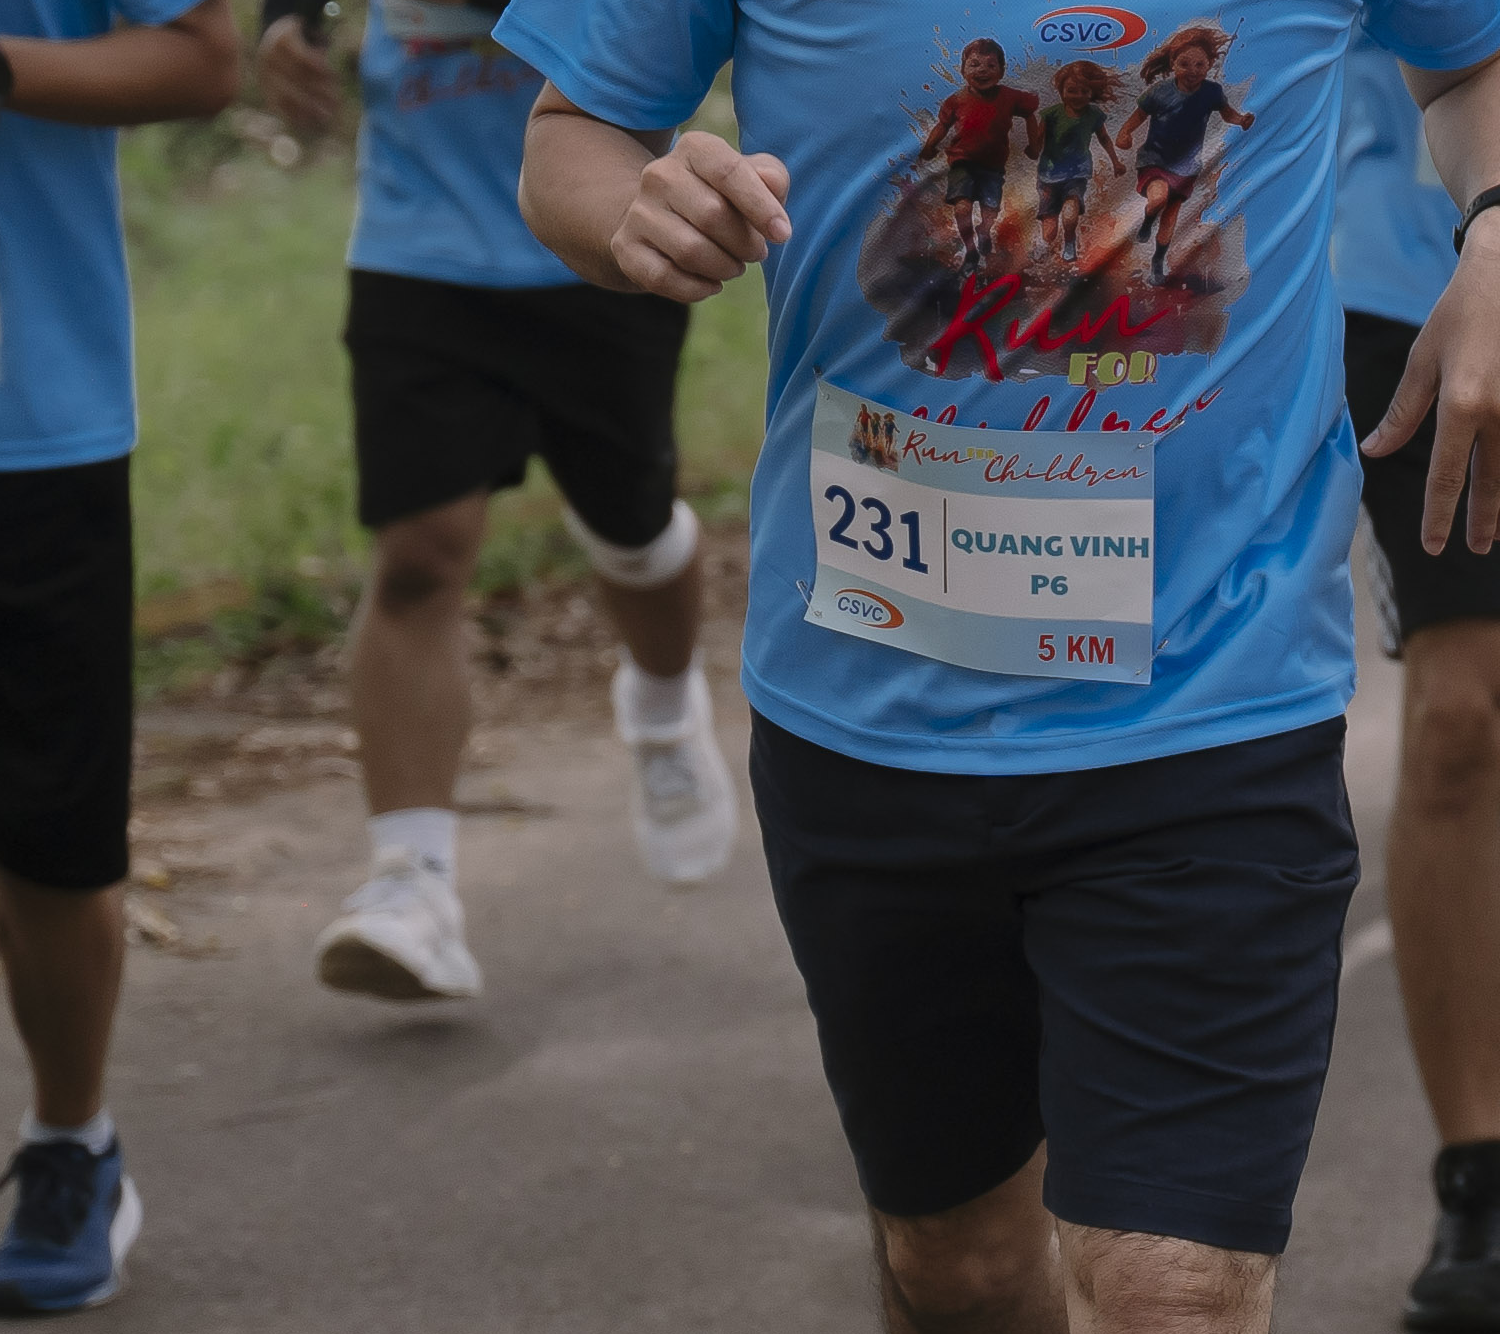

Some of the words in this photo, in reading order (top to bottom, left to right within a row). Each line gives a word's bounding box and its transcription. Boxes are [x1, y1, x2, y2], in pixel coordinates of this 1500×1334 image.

[1040, 22, 1114, 43] CSVC
[930, 272, 1172, 383] Run
[1068, 350, 1158, 385] FOR
[902, 430, 972, 465] Run
[984, 453, 1148, 487] Children
[823, 484, 929, 575] 231
[951, 528, 1064, 557] QUANG
[1072, 535, 1150, 559] VINH
[1030, 574, 1069, 596] P6
[836, 595, 884, 623] CSVC
[1037, 634, 1056, 663] 5
[1066, 634, 1115, 666] KM
